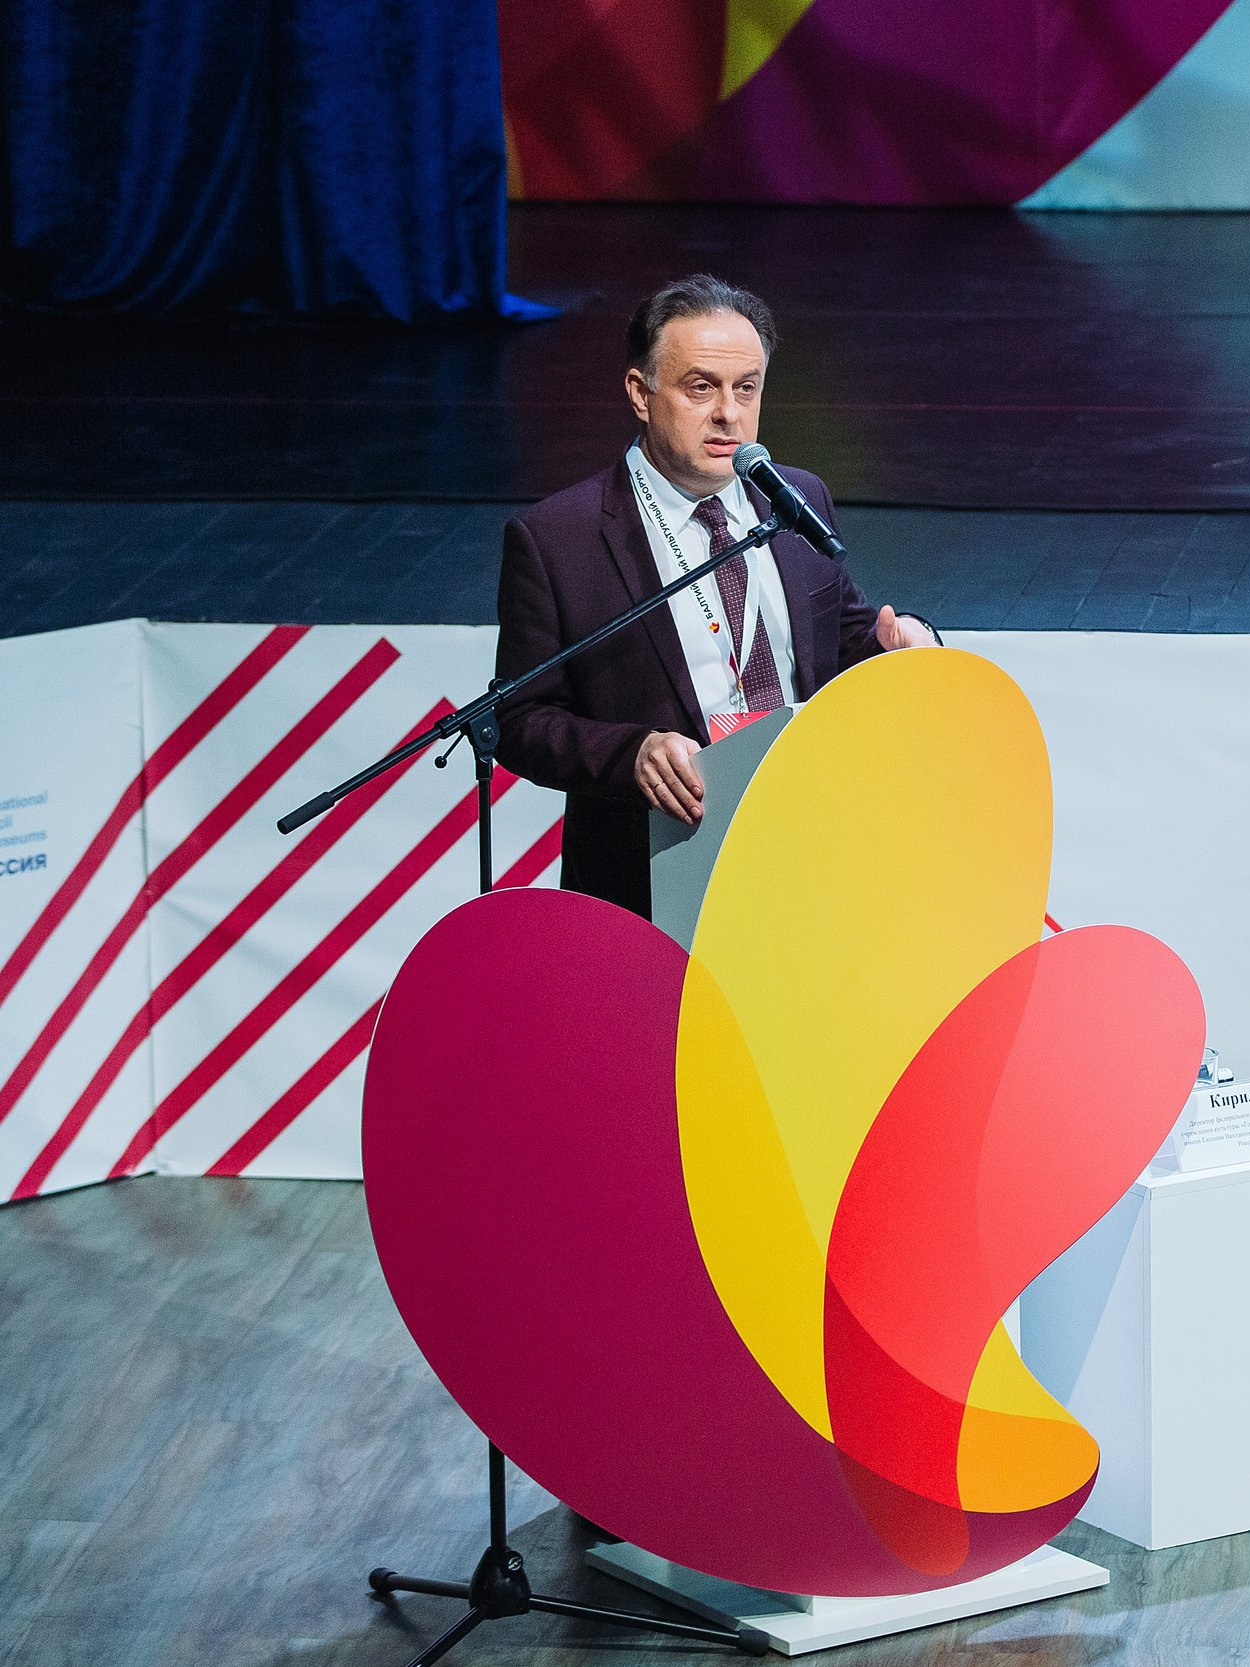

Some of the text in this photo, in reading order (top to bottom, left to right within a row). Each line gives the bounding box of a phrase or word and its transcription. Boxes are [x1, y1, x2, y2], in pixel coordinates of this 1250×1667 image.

[635, 469, 714, 620] БАЛТИЙИЙ КУЛЬТУРНЫЙ ФОРУМ
